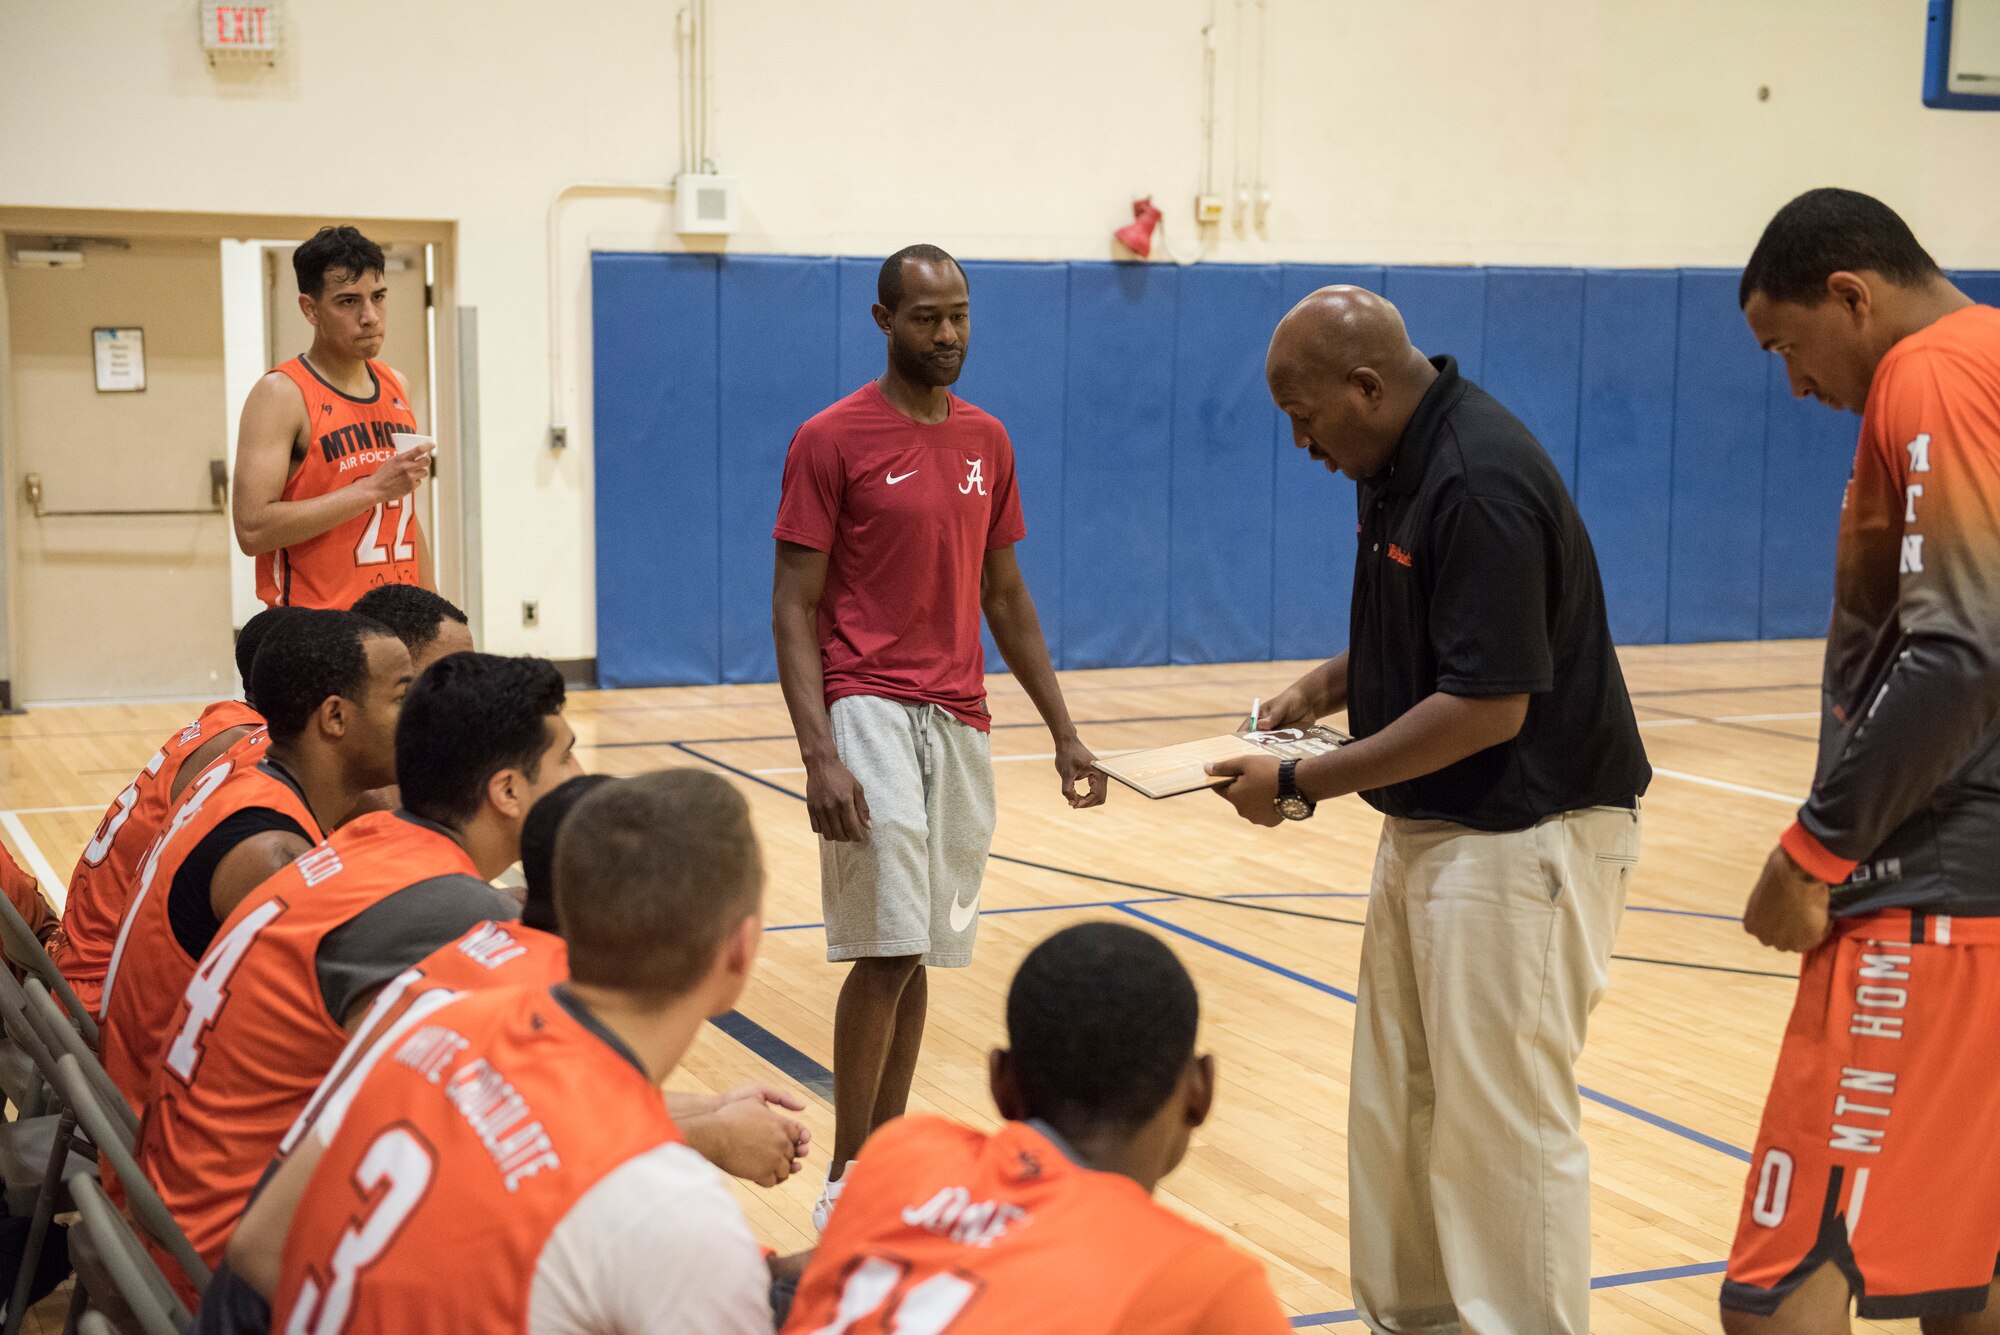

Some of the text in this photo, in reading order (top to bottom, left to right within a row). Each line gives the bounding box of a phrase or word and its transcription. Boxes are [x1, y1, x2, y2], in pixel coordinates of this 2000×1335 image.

[217, 6, 266, 44] EXIT
[319, 422, 373, 464] MTN
[339, 457, 358, 473] AIR
[958, 459, 986, 496] A
[164, 896, 288, 1087] 4
[1829, 1066, 1898, 1154] MTN
